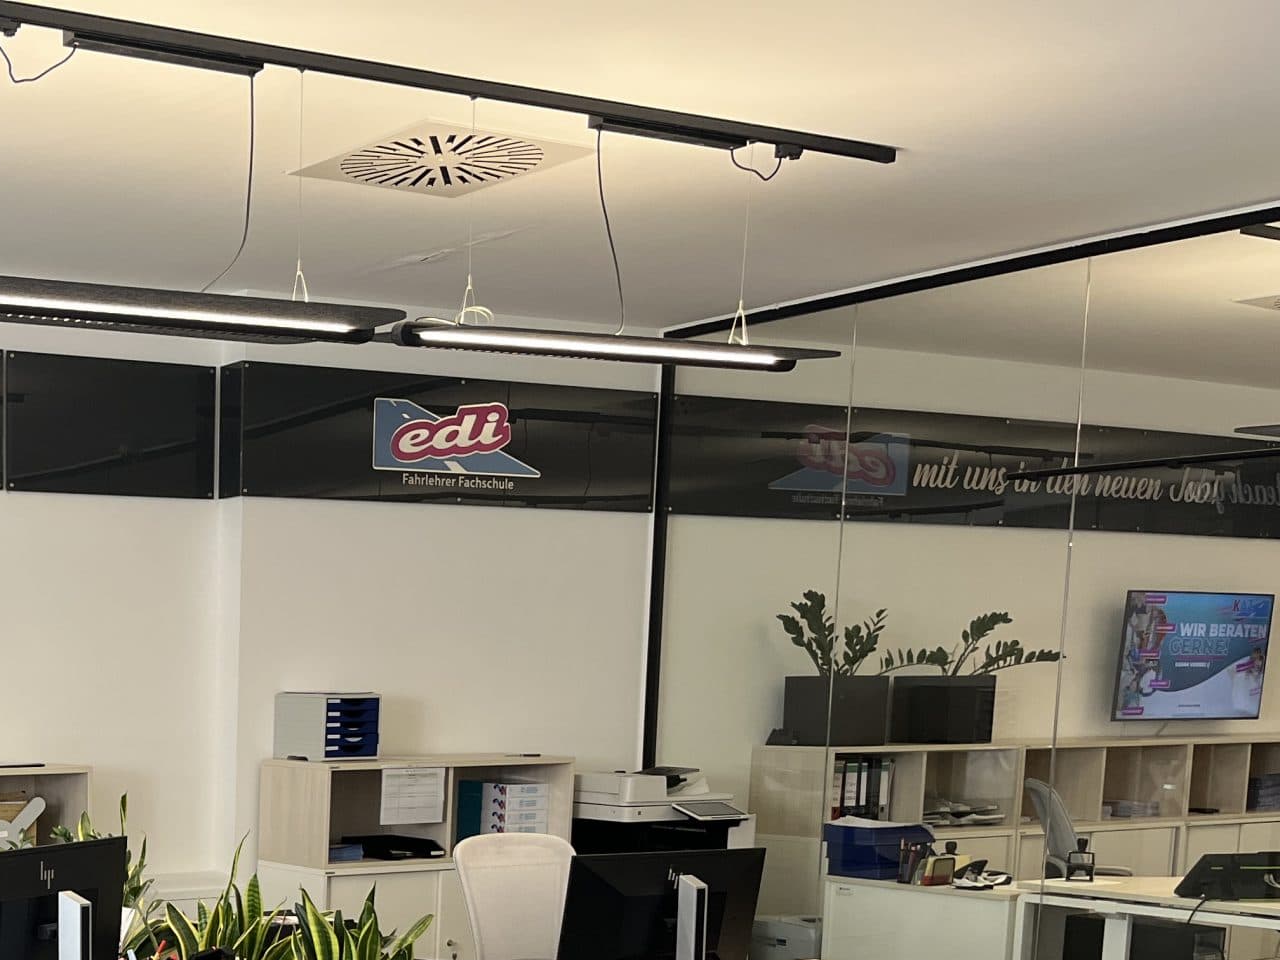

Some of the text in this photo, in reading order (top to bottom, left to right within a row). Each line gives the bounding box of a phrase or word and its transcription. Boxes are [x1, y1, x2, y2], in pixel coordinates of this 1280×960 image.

[398, 411, 504, 454] edi
[402, 472, 514, 490] Fahrlehrer Fachschule
[912, 449, 961, 489] mit
[963, 464, 1011, 495] uns
[1095, 473, 1164, 501] neuen
[1179, 622, 1267, 638] WIR BERATEN
[40, 860, 55, 890] hp
